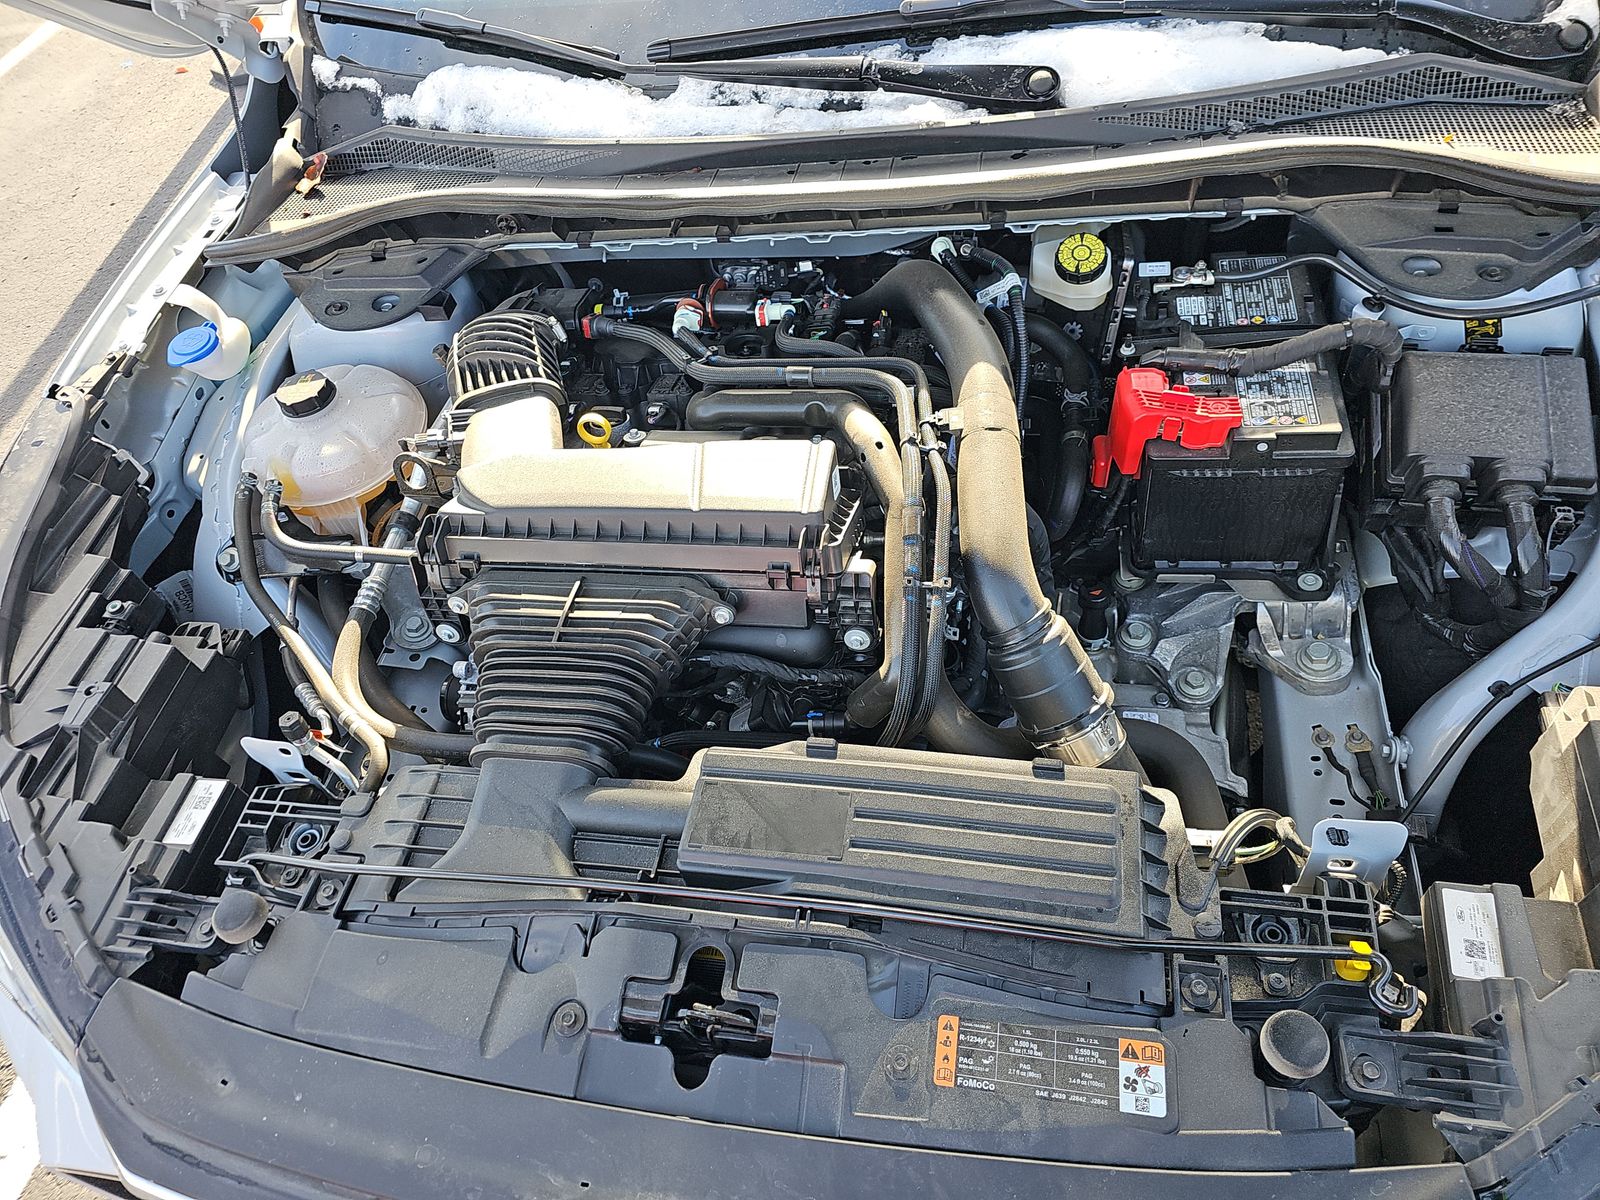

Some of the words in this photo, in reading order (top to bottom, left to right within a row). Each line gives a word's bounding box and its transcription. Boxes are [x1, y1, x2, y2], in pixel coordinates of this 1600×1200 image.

[959, 1034, 987, 1044] R-1234yf
[1030, 1042, 1037, 1051] kg
[1091, 1049, 1099, 1058] kg
[957, 1077, 995, 1091] FoMoCo
